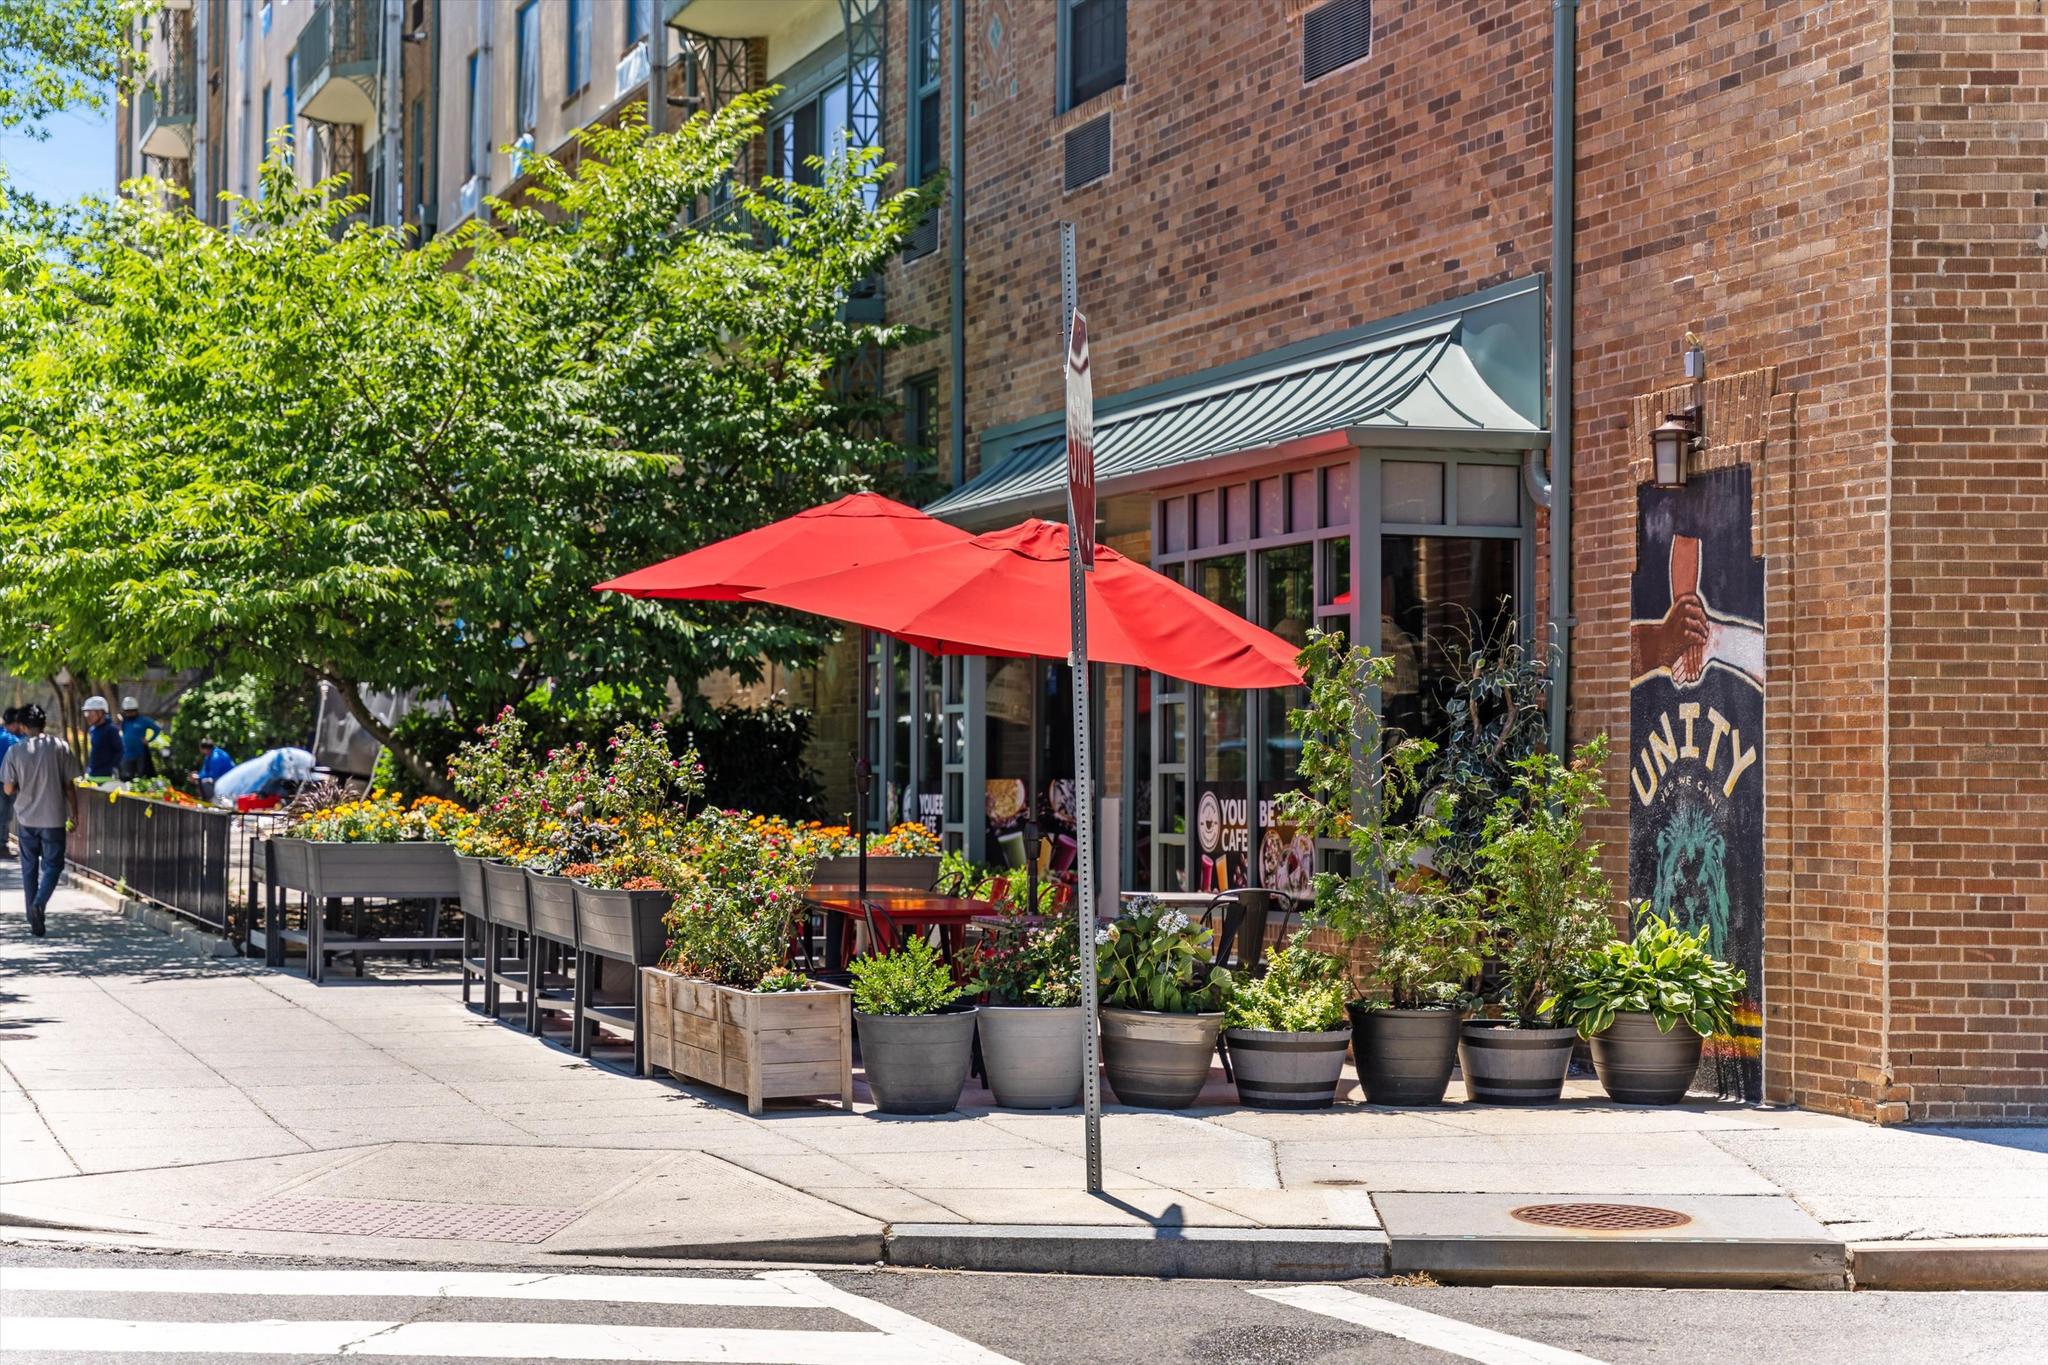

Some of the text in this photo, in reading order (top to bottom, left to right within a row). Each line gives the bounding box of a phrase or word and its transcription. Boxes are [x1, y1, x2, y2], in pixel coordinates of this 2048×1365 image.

[1631, 702, 1757, 807] UNITY
[1660, 780, 1674, 803] YES
[1678, 775, 1692, 787] WE
[1220, 799, 1247, 826] YOU
[1259, 800, 1276, 827] BE
[1221, 828, 1248, 851] CAFE
